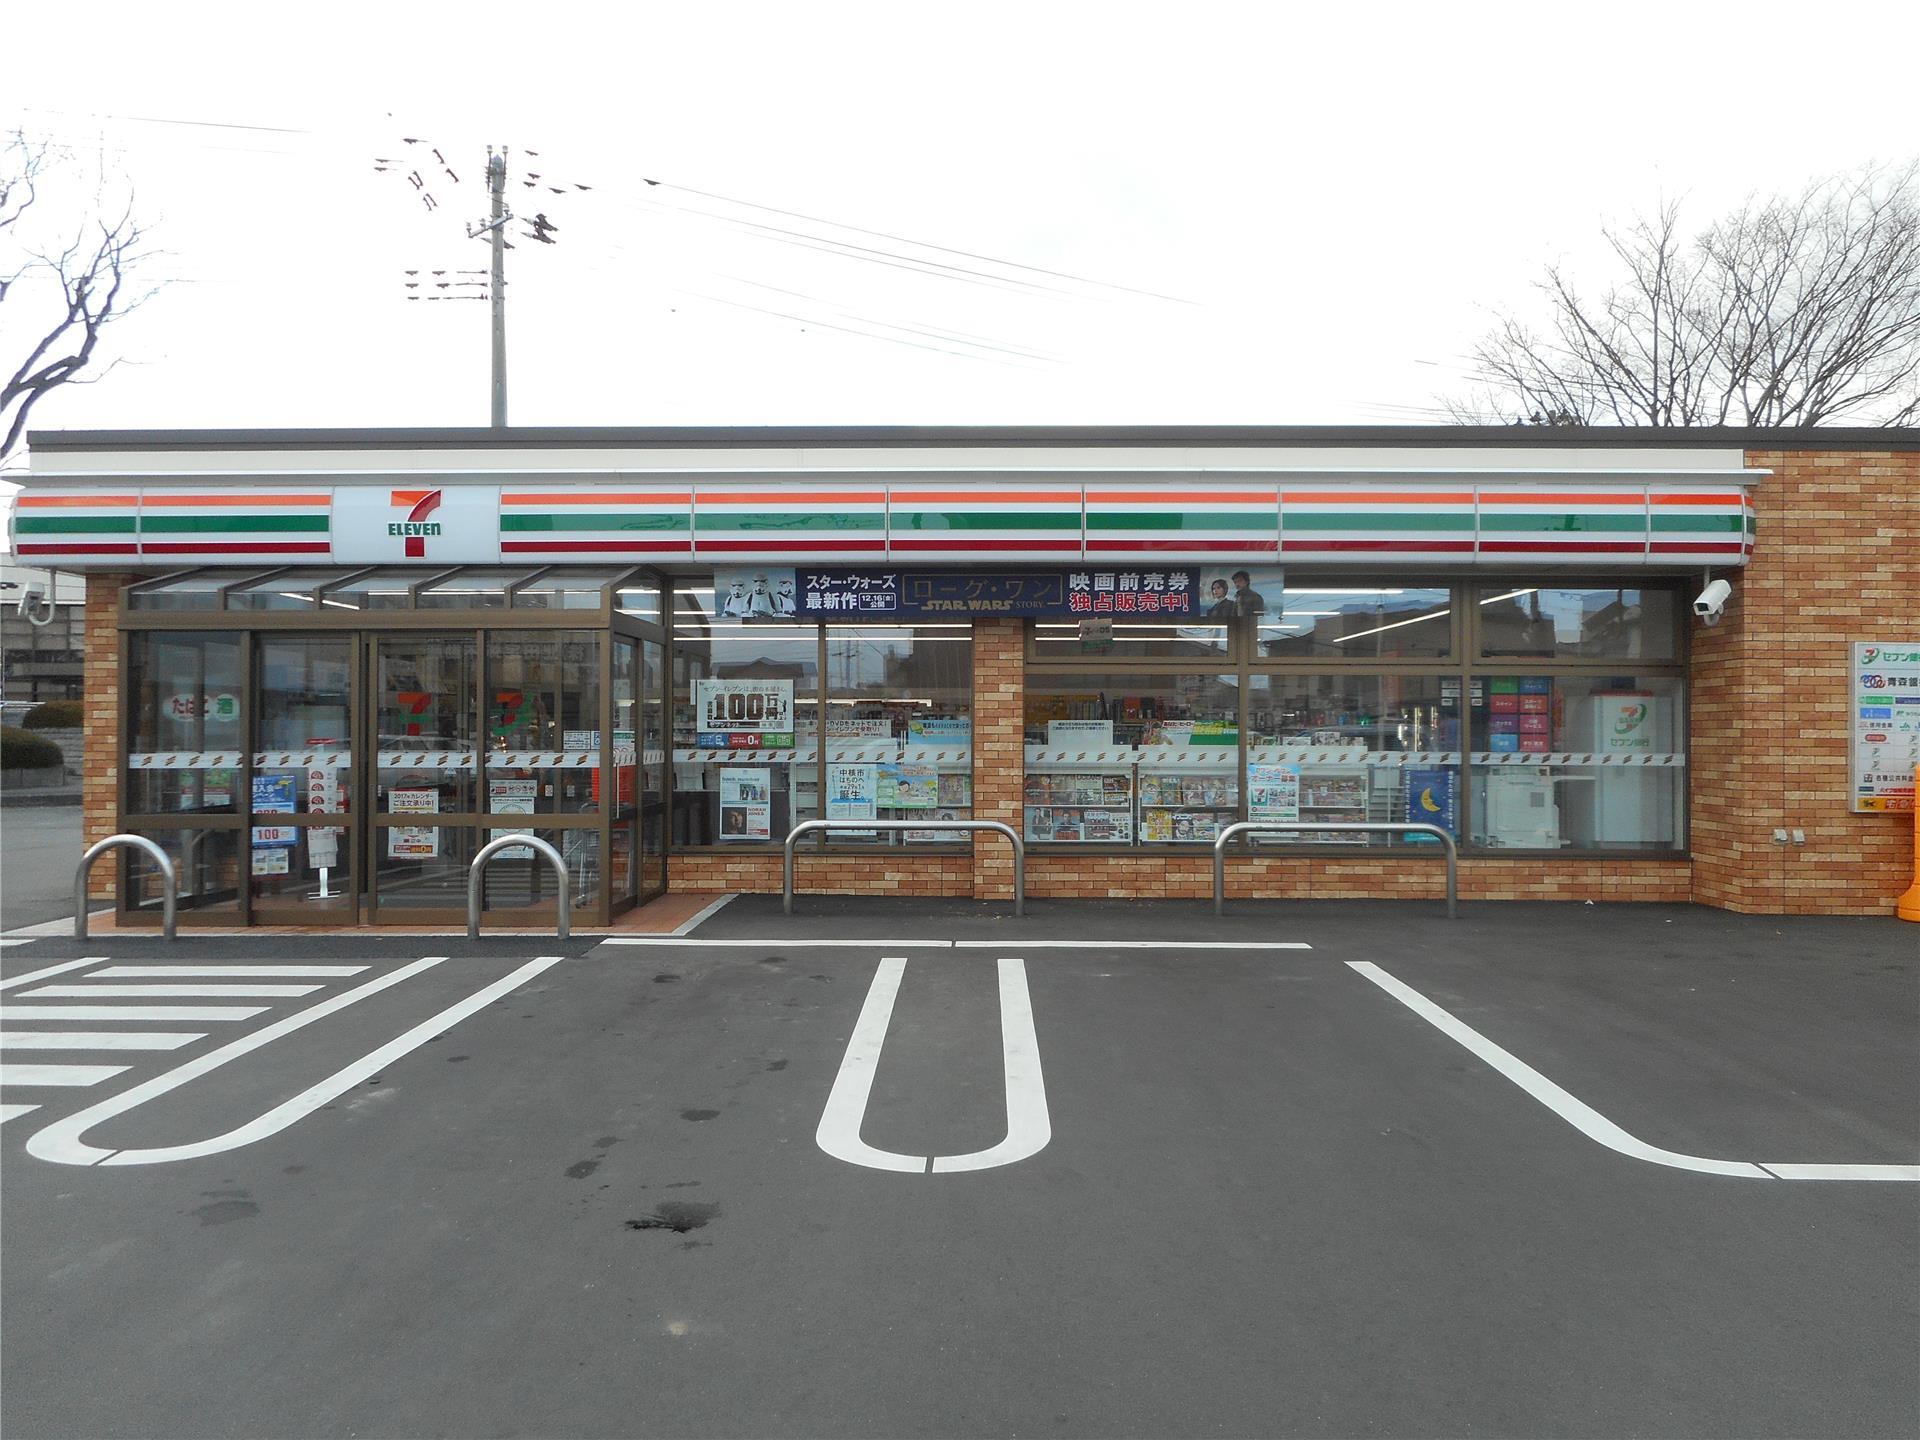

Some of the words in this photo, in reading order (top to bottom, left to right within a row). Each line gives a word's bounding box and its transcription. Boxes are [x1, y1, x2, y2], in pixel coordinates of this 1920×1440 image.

[391, 490, 441, 557] 7
[806, 574, 897, 590] スター・ウォーズ
[914, 577, 1052, 599] ローグ・ワン
[1069, 572, 1189, 591] 映画前売券
[806, 592, 857, 610] 最新作
[921, 600, 967, 610] STAR
[968, 600, 1013, 610] WARS
[1069, 591, 1190, 611] 独占販売中!
[1883, 652, 1920, 662] セブン銀
[1888, 676, 1920, 687] 青森銀
